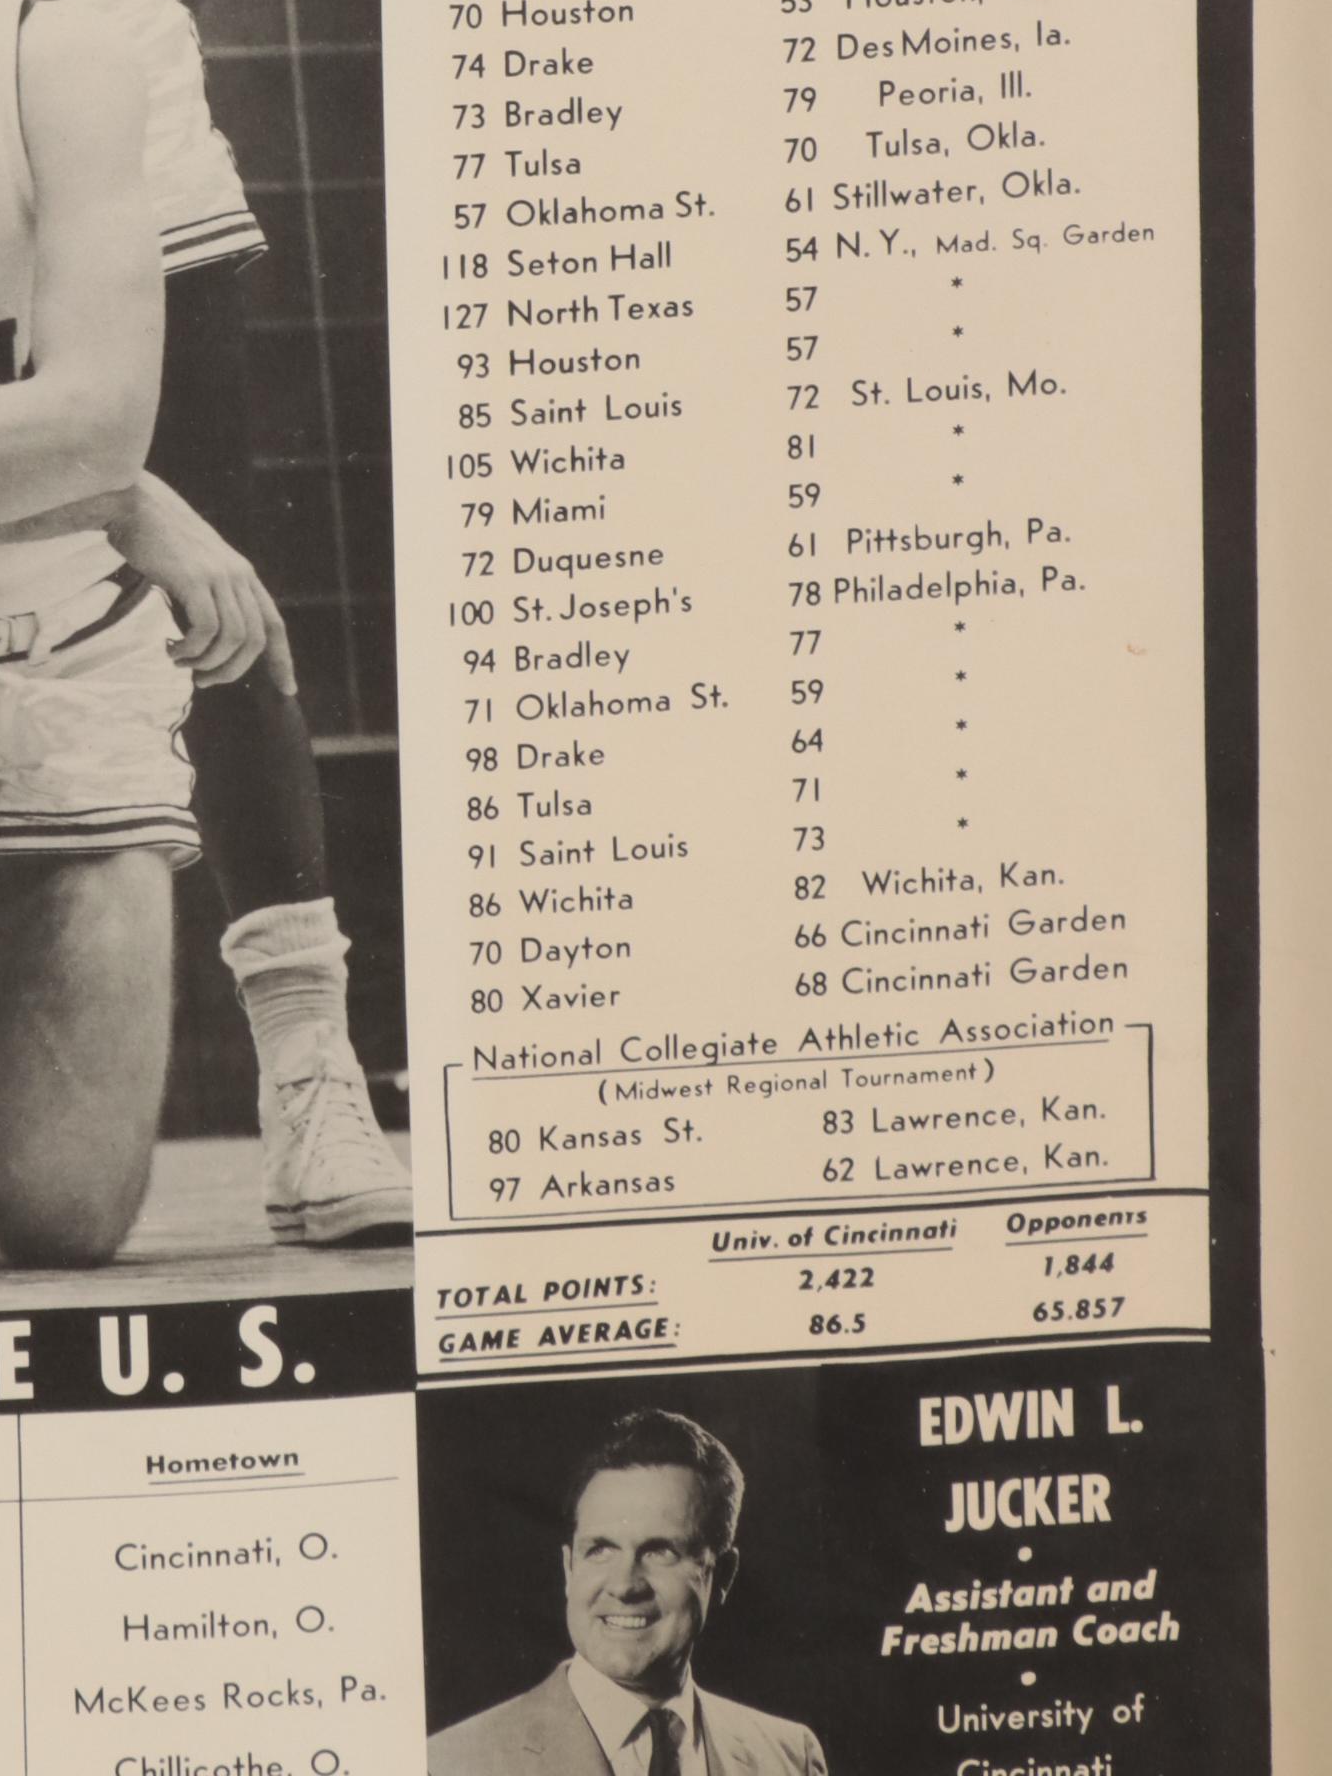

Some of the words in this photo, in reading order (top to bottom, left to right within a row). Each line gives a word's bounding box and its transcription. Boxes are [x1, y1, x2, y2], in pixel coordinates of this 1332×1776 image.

[453, 152, 486, 180] 77
[504, 148, 581, 177] Tulsa
[784, 136, 818, 164] 70
[865, 127, 949, 158] Tulsa,
[966, 120, 1045, 151] Okla.
[461, 549, 494, 577] 72
[513, 547, 664, 577] Duquesne
[787, 532, 816, 558] 61
[847, 519, 1010, 556] Pittsburgh,
[1027, 517, 1071, 545] Pa.
[469, 940, 502, 966] 70
[520, 936, 631, 964] Dayton
[794, 923, 827, 949] 66
[840, 913, 989, 947] Cincinnati
[1008, 903, 1126, 936] Garden
[473, 1037, 601, 1071] National
[620, 1031, 778, 1064] Collegiate
[798, 1021, 919, 1053] Athletic
[939, 1010, 1114, 1044] Association
[488, 1128, 521, 1155] 80
[539, 1124, 642, 1152] Kansas
[663, 1117, 702, 1144] St.
[822, 1108, 854, 1135] 83
[872, 1107, 1025, 1133] Lawrence,
[1041, 1099, 1106, 1122] Kan.
[711, 1230, 779, 1254] Univ.
[787, 1225, 814, 1248] of
[823, 1217, 957, 1247] Cincinnati
[436, 1283, 528, 1310] TOTAL
[542, 1273, 656, 1303] POINTS:
[798, 1265, 875, 1293] 2,422
[1044, 1251, 1115, 1279] 1,844
[99, 1314, 185, 1396] U.
[238, 1304, 316, 1388] S.
[438, 1327, 521, 1355] GAME
[537, 1316, 681, 1348] AVERAGE:
[808, 1312, 866, 1336] 86.5
[1032, 1296, 1126, 1324] 65.857
[919, 1388, 1074, 1447] EDWIN
[1106, 1385, 1144, 1434] L.
[146, 1452, 301, 1476] Hometown
[945, 1473, 1112, 1533] JUCKER
[114, 1539, 280, 1571] Cincinnati,
[298, 1532, 338, 1561] O.
[904, 1576, 1074, 1614] Assistant
[1087, 1568, 1157, 1603] and
[123, 1610, 277, 1641] Hamilton,
[295, 1605, 334, 1633] O.
[881, 1621, 1058, 1656] Freshman
[1072, 1610, 1180, 1646] Coach
[74, 1685, 206, 1714] McKees
[223, 1678, 322, 1709] Rocks,
[340, 1675, 387, 1702] Pa.
[938, 1699, 1093, 1735] University
[1112, 1692, 1145, 1724] of
